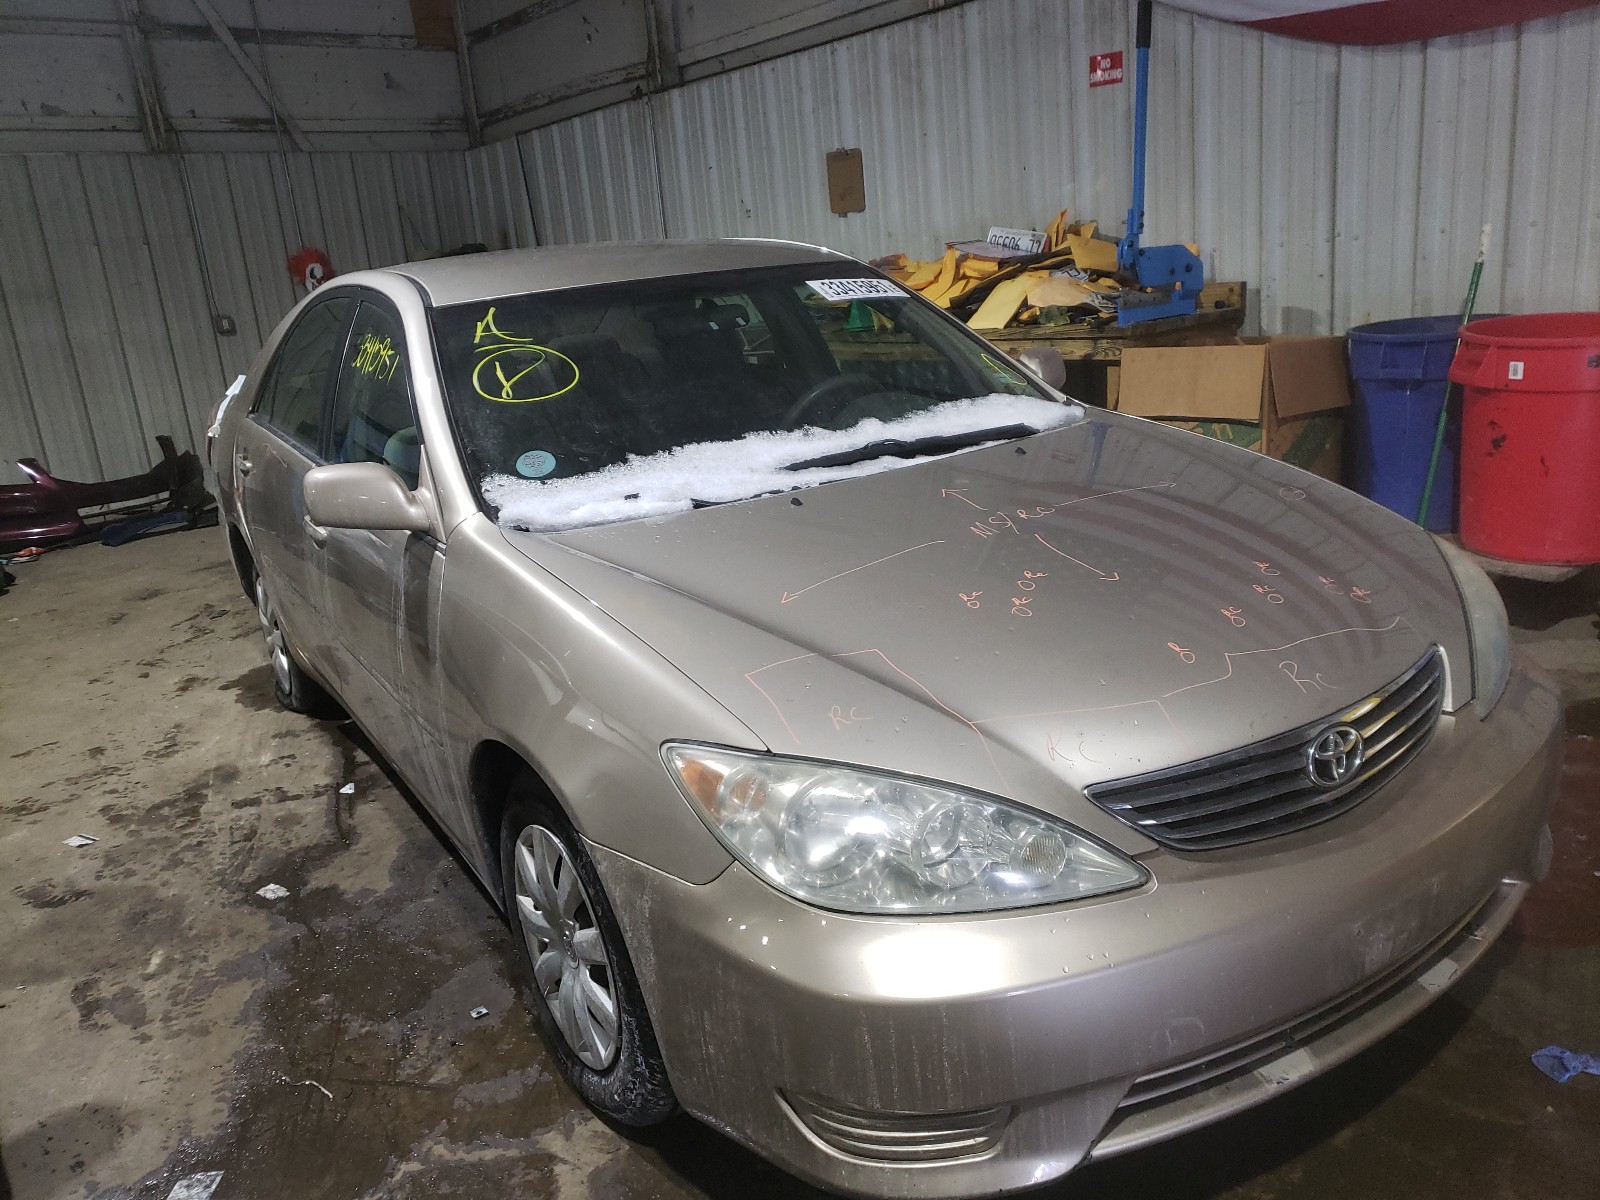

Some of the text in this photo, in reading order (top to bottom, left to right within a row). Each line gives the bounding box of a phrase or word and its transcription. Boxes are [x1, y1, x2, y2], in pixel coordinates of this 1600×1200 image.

[1100, 57, 1111, 69] NO
[1090, 68, 1123, 82] SMOKING
[820, 280, 893, 296] 33415951
